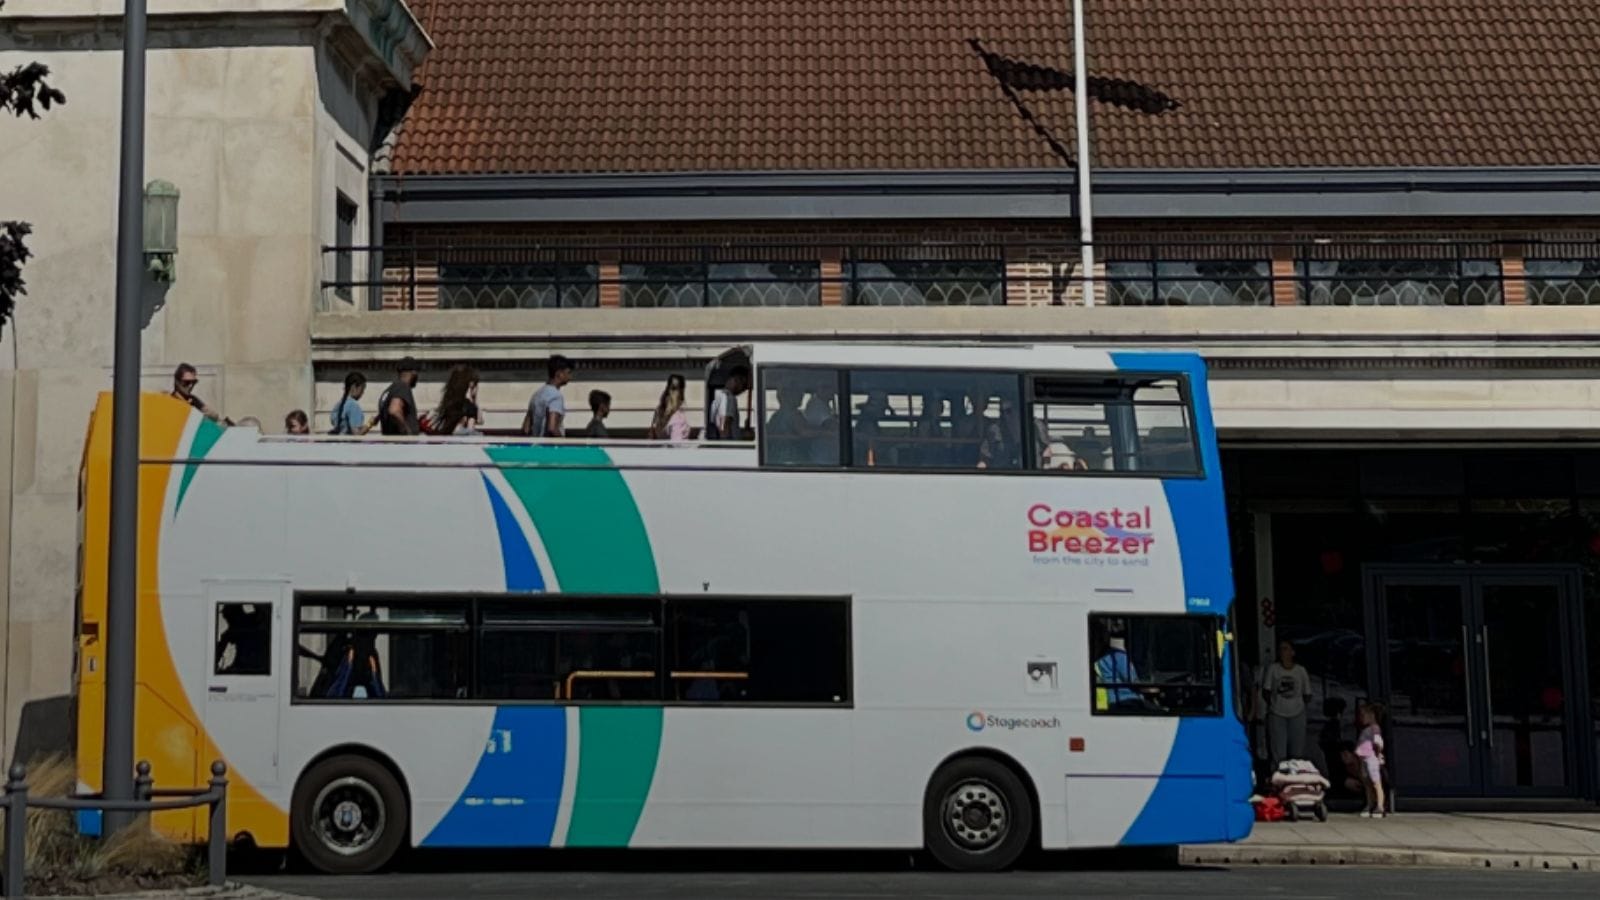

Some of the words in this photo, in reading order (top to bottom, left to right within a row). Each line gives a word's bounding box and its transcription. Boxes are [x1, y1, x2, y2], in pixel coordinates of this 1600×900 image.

[1027, 503, 1151, 529] Coastal
[1028, 530, 1155, 554] Breezer
[1062, 556, 1081, 566] the
[1084, 556, 1104, 568] city
[1108, 557, 1119, 566] to
[987, 715, 1061, 730] Stagecoach
